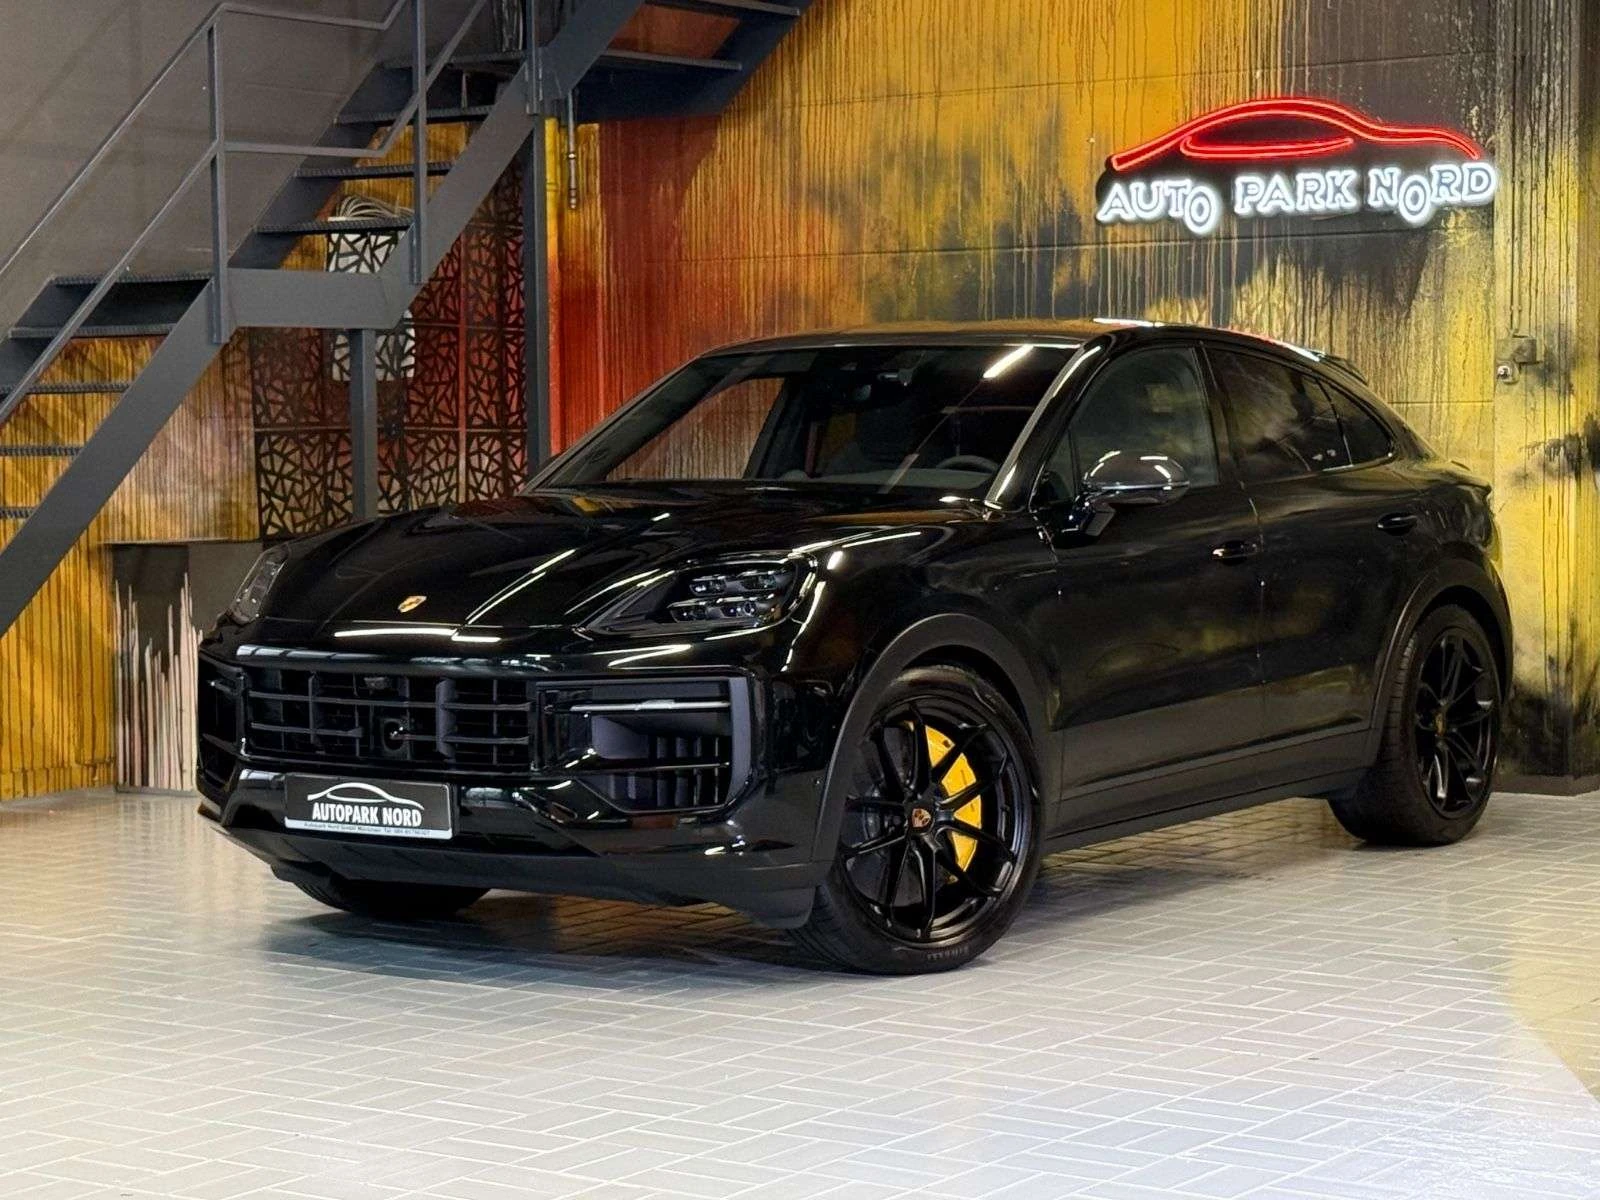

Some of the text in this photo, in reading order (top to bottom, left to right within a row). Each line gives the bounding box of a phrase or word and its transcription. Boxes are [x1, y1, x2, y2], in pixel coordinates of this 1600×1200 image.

[1096, 162, 1497, 233] AUTO PARK NORD
[311, 802, 422, 828] AUTOPARK NORD
